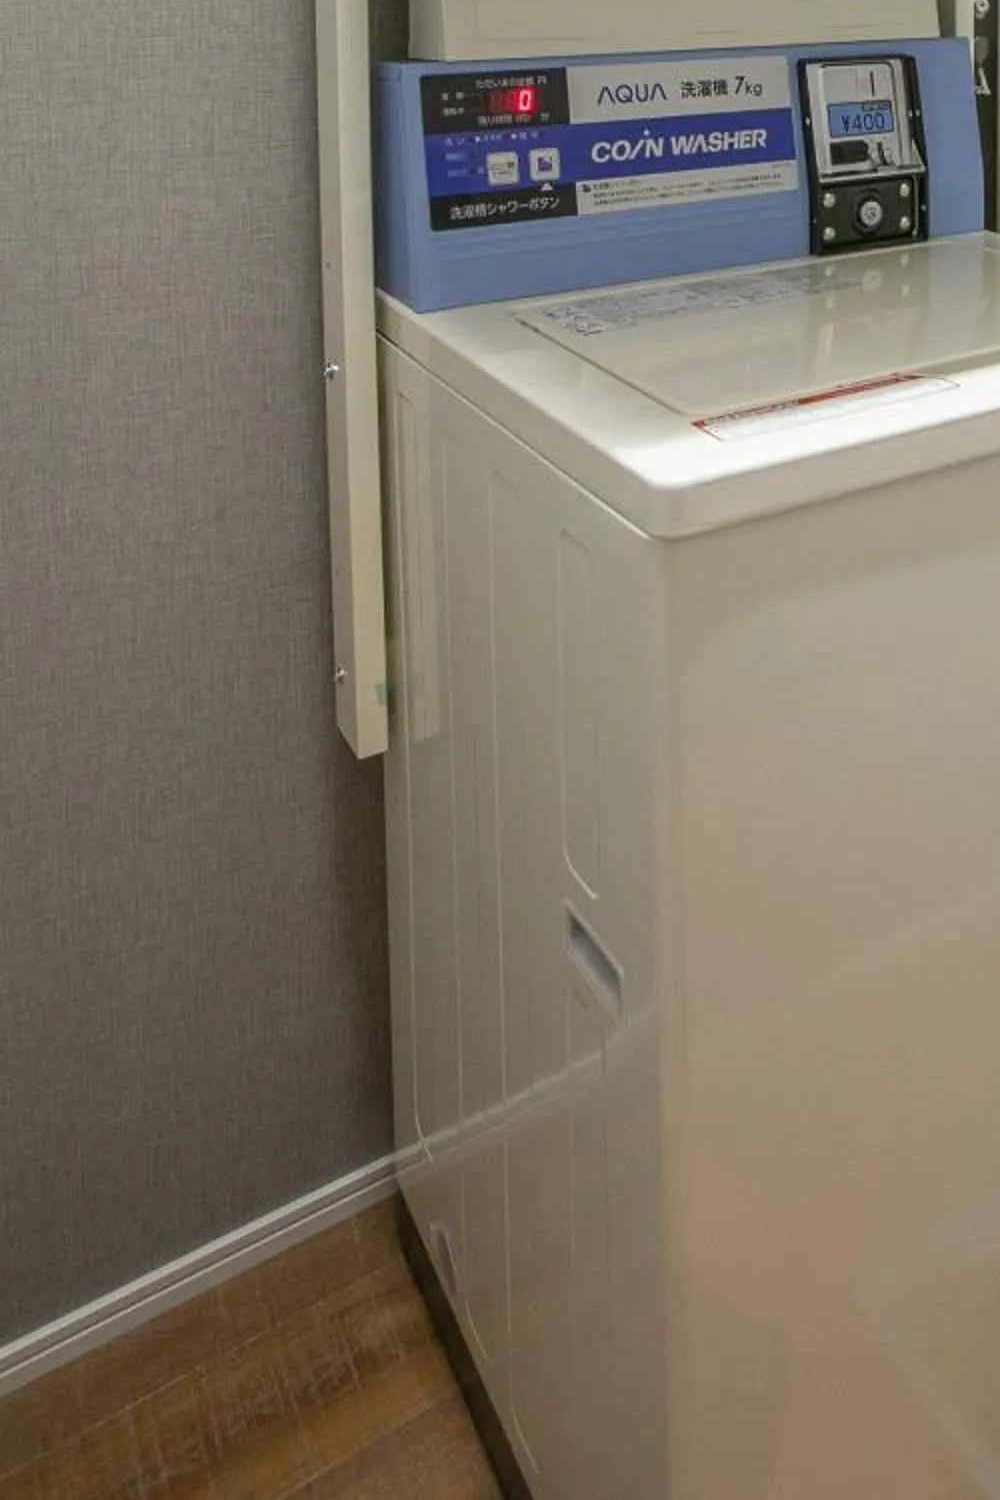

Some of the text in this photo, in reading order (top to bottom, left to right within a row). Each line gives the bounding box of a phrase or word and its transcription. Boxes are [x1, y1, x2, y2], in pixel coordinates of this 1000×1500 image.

[518, 89, 533, 112] 0
[597, 75, 763, 105] AQUA 洗濯機 7kg
[841, 112, 885, 133] ¥400
[671, 128, 767, 155] WASHER
